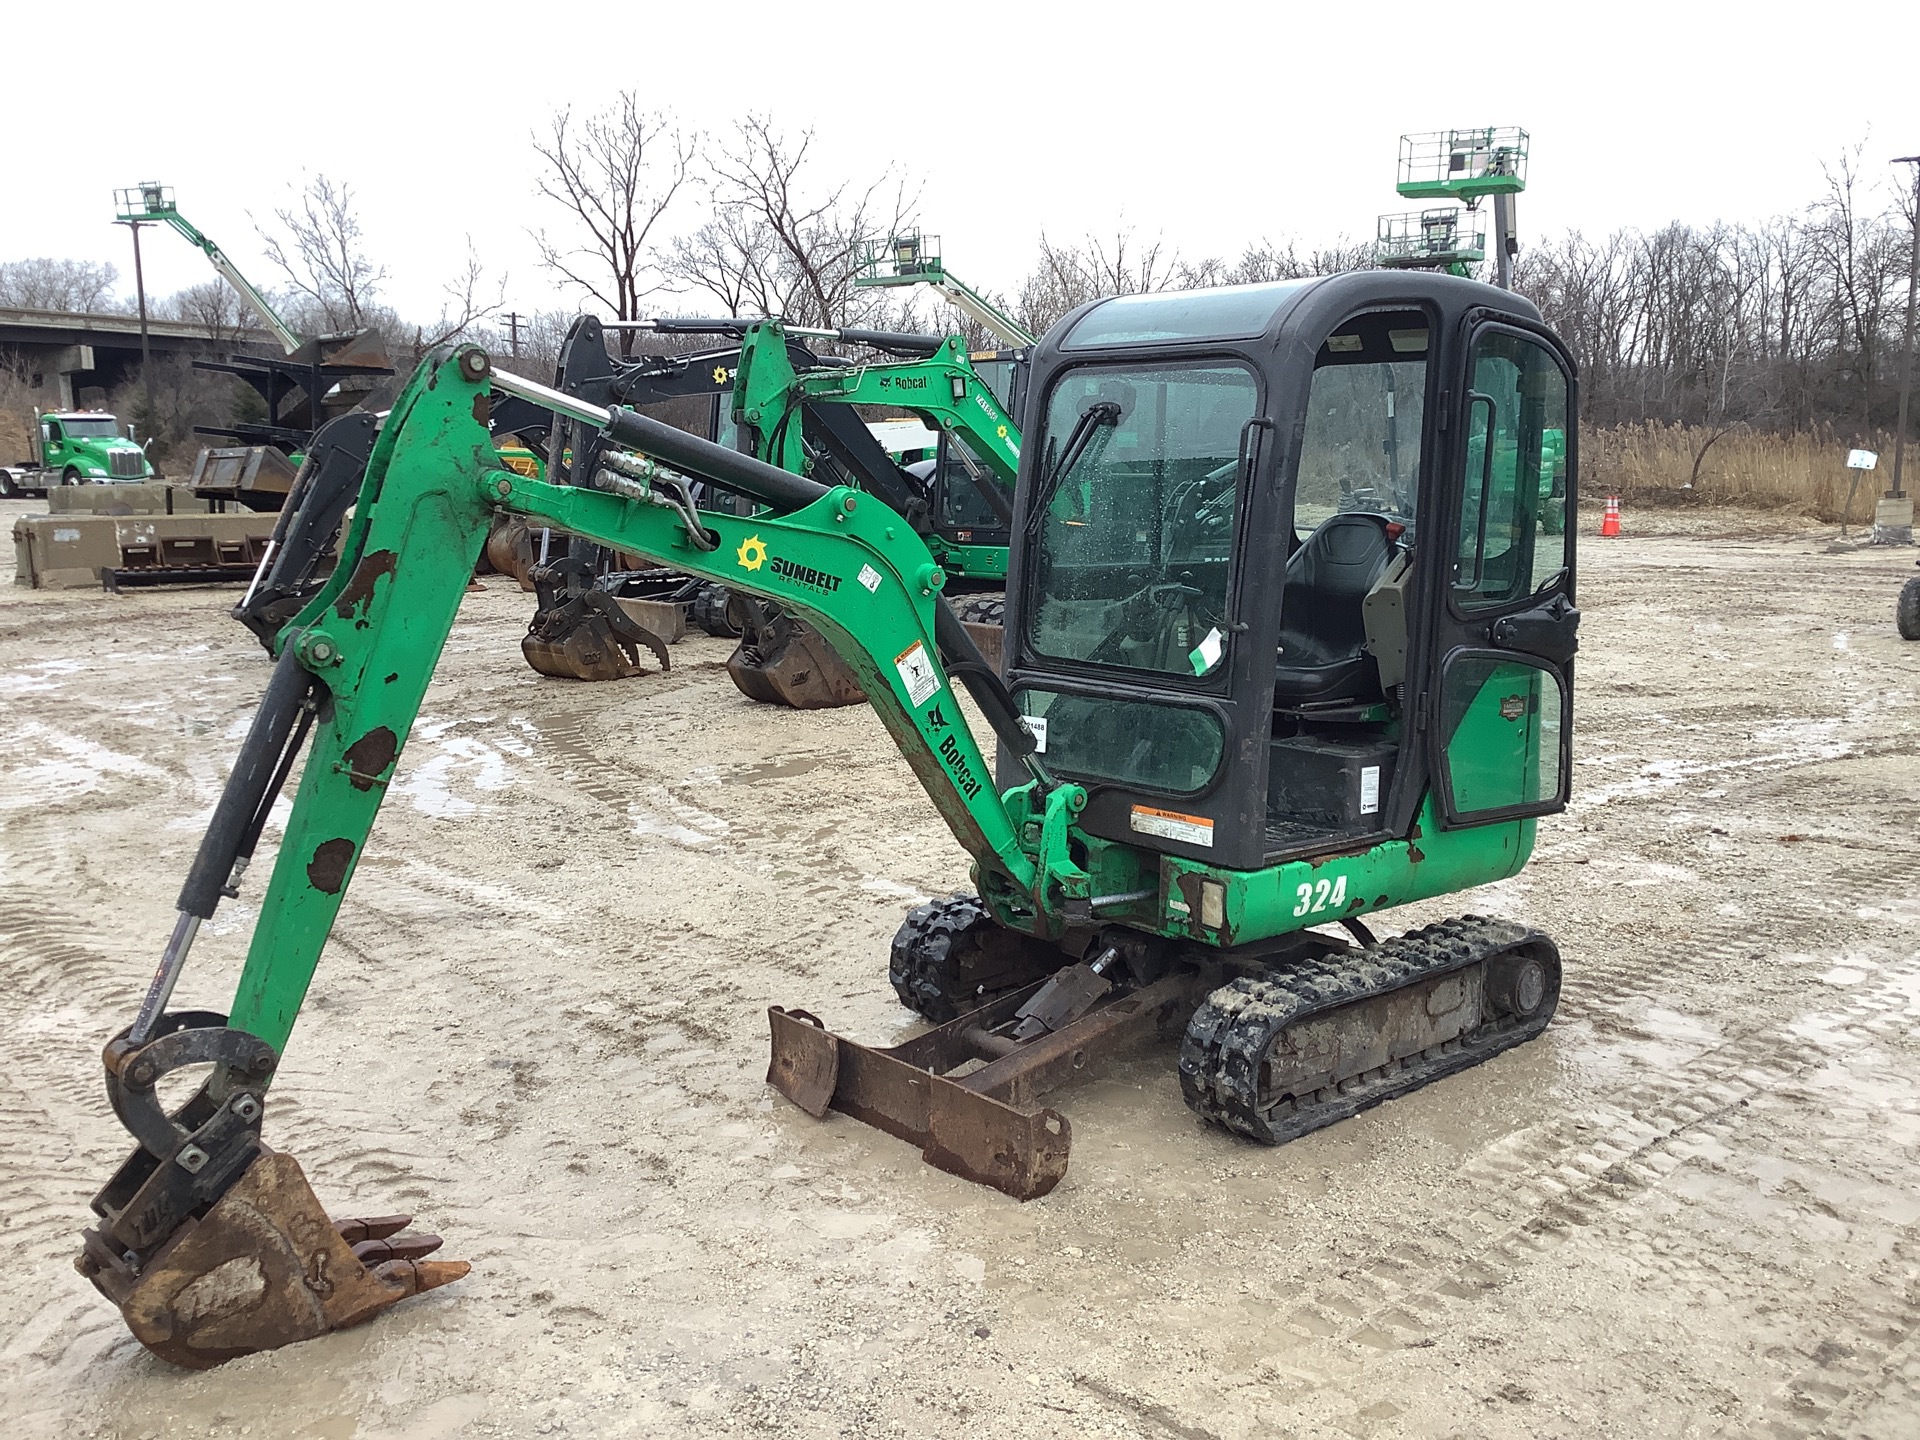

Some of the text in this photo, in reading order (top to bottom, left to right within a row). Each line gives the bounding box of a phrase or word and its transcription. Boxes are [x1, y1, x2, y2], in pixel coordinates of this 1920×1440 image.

[895, 376, 927, 390] Bobcat
[770, 556, 843, 592] SUNBELT
[778, 575, 829, 596] RENTALS
[938, 733, 982, 801] Bobcat
[1162, 811, 1187, 821] WARNING
[1293, 875, 1348, 917] 324
